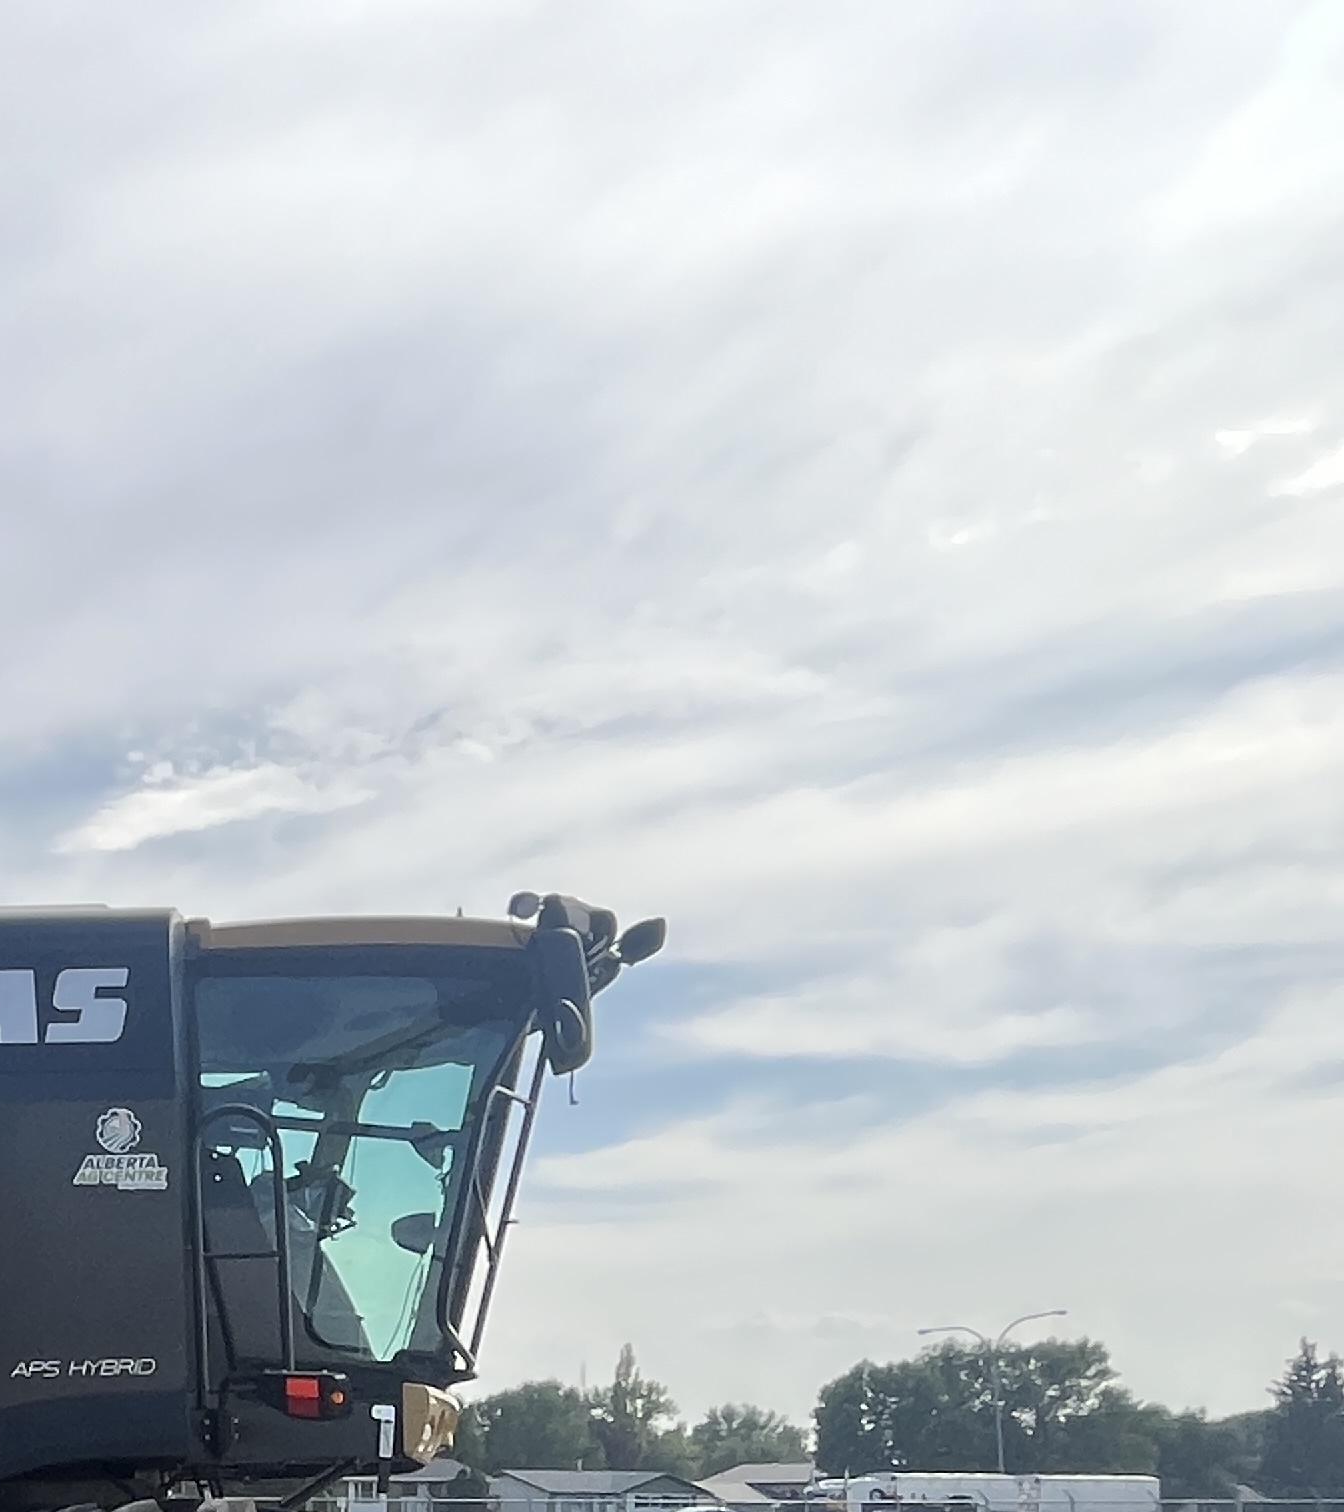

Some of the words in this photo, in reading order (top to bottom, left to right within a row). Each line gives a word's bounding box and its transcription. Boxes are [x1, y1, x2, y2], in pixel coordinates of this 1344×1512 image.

[83, 1155, 156, 1169] ALBERTA
[11, 1360, 62, 1378] APS
[67, 1358, 157, 1377] HYBRID
